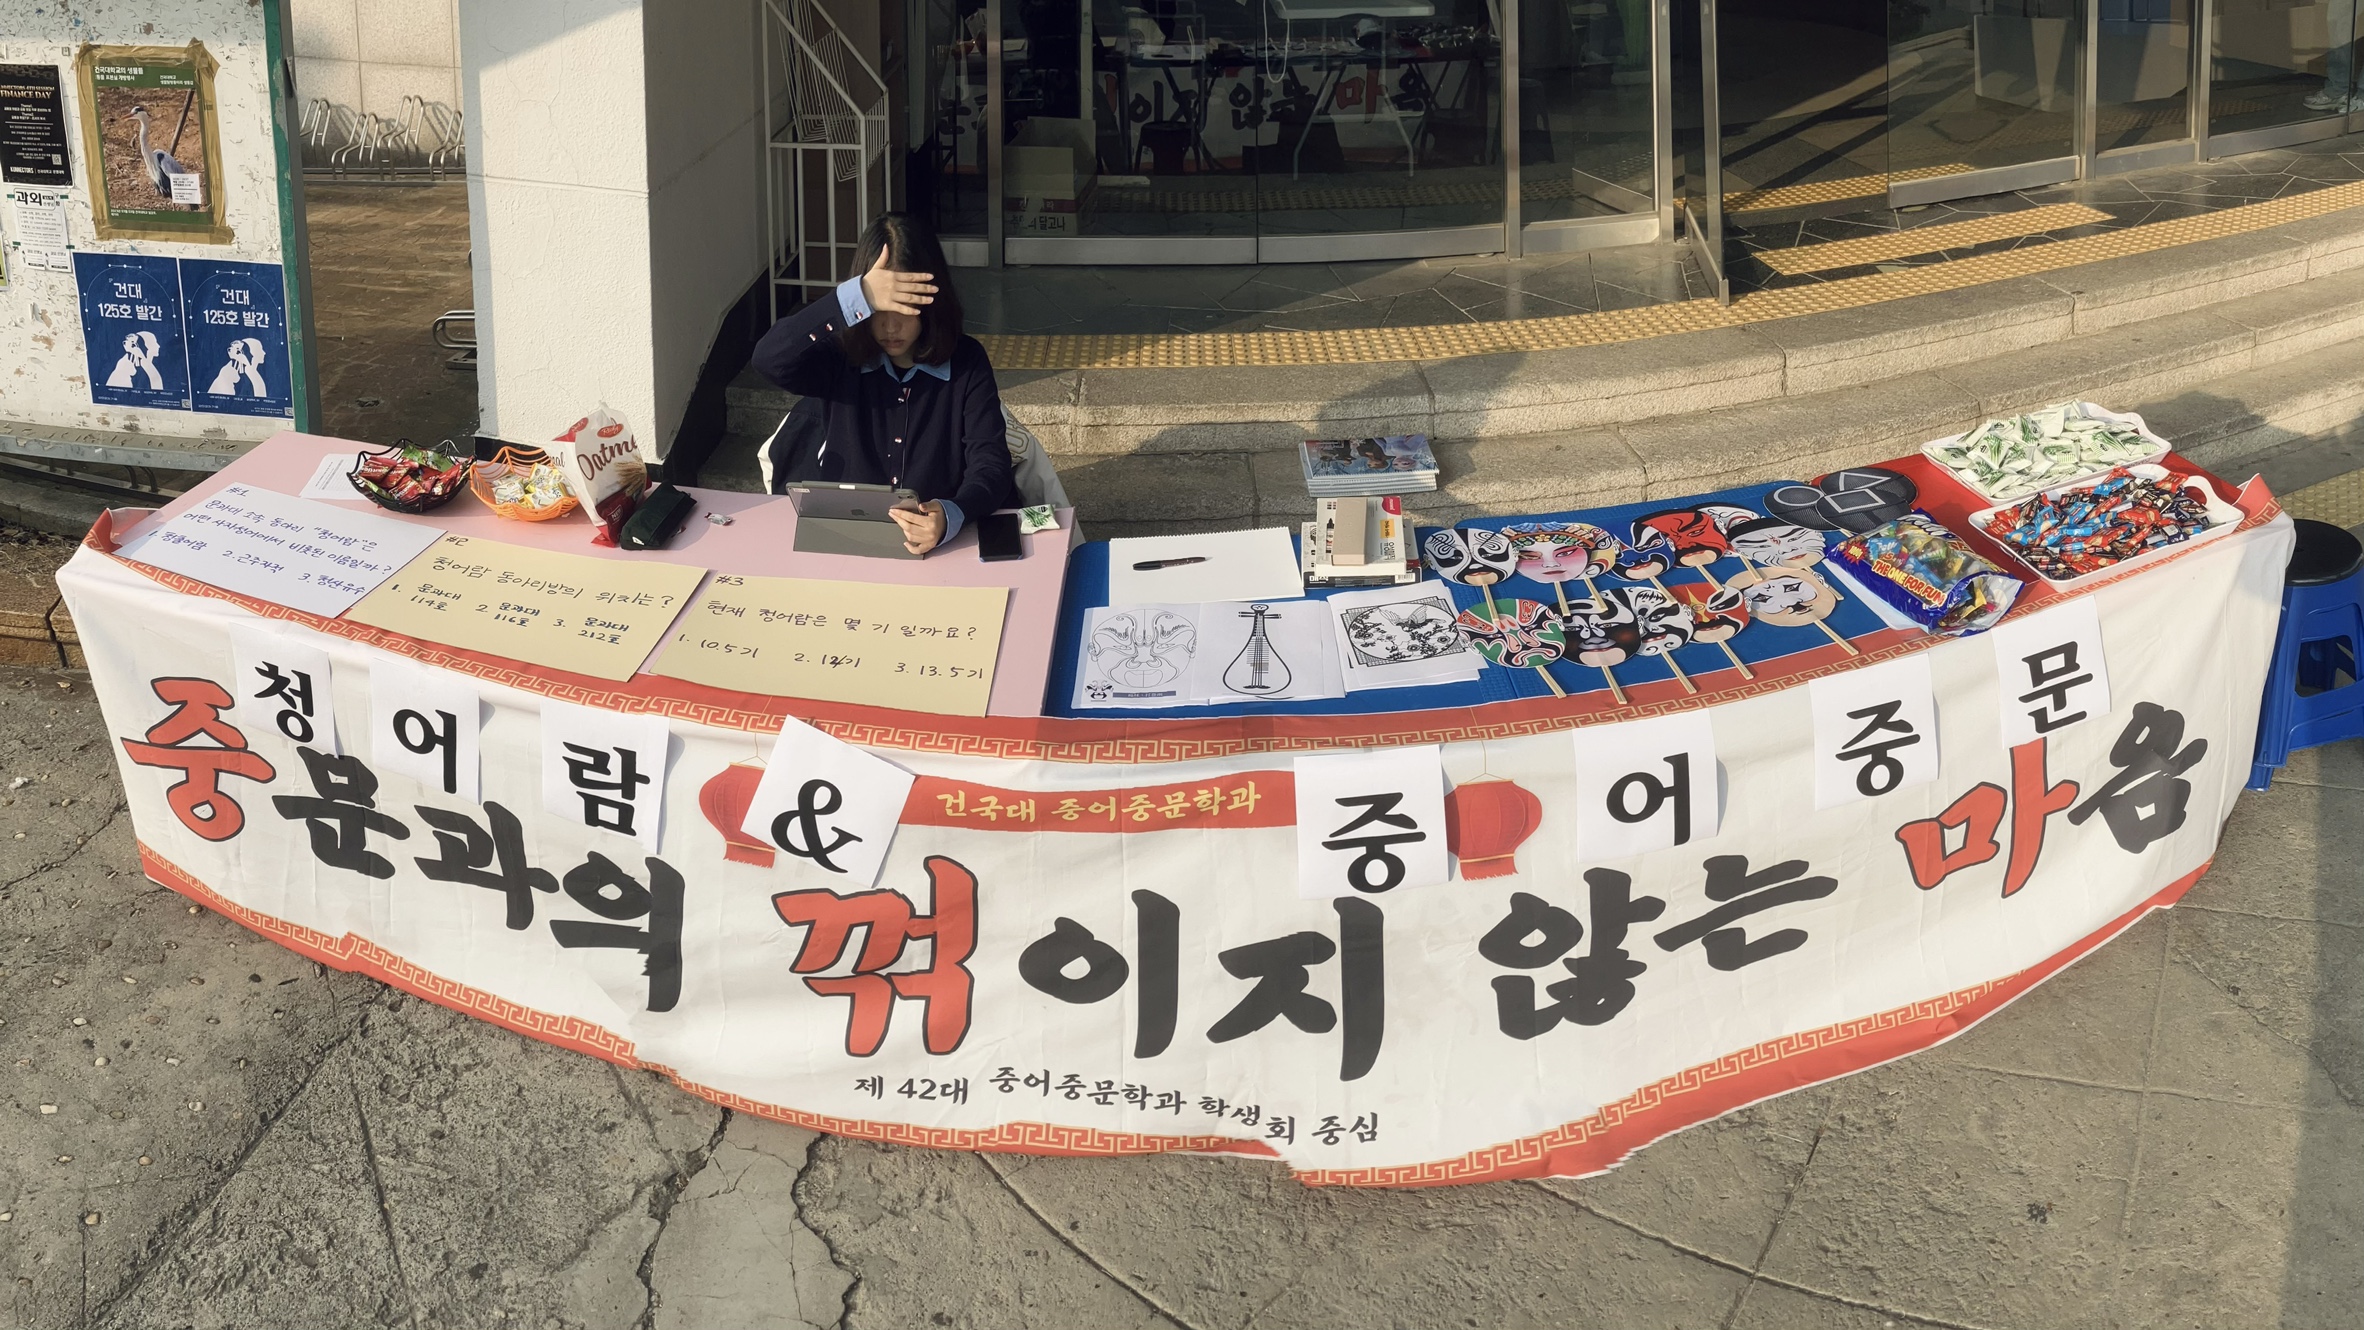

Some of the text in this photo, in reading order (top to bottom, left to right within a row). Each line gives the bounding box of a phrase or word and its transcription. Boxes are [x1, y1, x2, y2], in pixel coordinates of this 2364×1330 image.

[16, 191, 42, 206] 과외
[1038, 216, 1066, 232] 달고나
[98, 303, 163, 321] 125호 발간
[203, 309, 270, 328] 125호 발간
[226, 486, 249, 497] #1
[205, 500, 244, 514] 문과대
[243, 511, 266, 524] 소속
[270, 518, 304, 532] 동아리
[184, 514, 211, 524] 어떤
[212, 519, 286, 546] 사자성어에서
[288, 542, 326, 558] 비롯된
[222, 550, 236, 559] 2.
[298, 572, 310, 583] 3.
[432, 556, 492, 580] 청어람
[497, 570, 585, 600] 동아리방의
[715, 575, 744, 587] #3
[1872, 560, 1948, 608] THE ONE FOR FUN
[392, 583, 462, 602] 1. 문과대
[410, 595, 448, 614] 114호
[499, 602, 542, 618] 문과대
[494, 613, 530, 628] 116호
[552, 616, 630, 633] 3. 문과대
[707, 600, 746, 618] 현재
[758, 608, 828, 628] 청어람은
[844, 617, 860, 633] 몇
[578, 629, 622, 646] 212호
[678, 634, 690, 642] 1.
[794, 653, 810, 664] 2.
[894, 662, 908, 674] 3.
[936, 781, 1262, 822] 건국대 중어중문학과
[770, 778, 864, 874] &
[120, 676, 2208, 1081] 중문과의 꺾이지 않는 마음
[854, 1066, 1379, 1146] 제 42대 중어중문학과 학생회 중심
